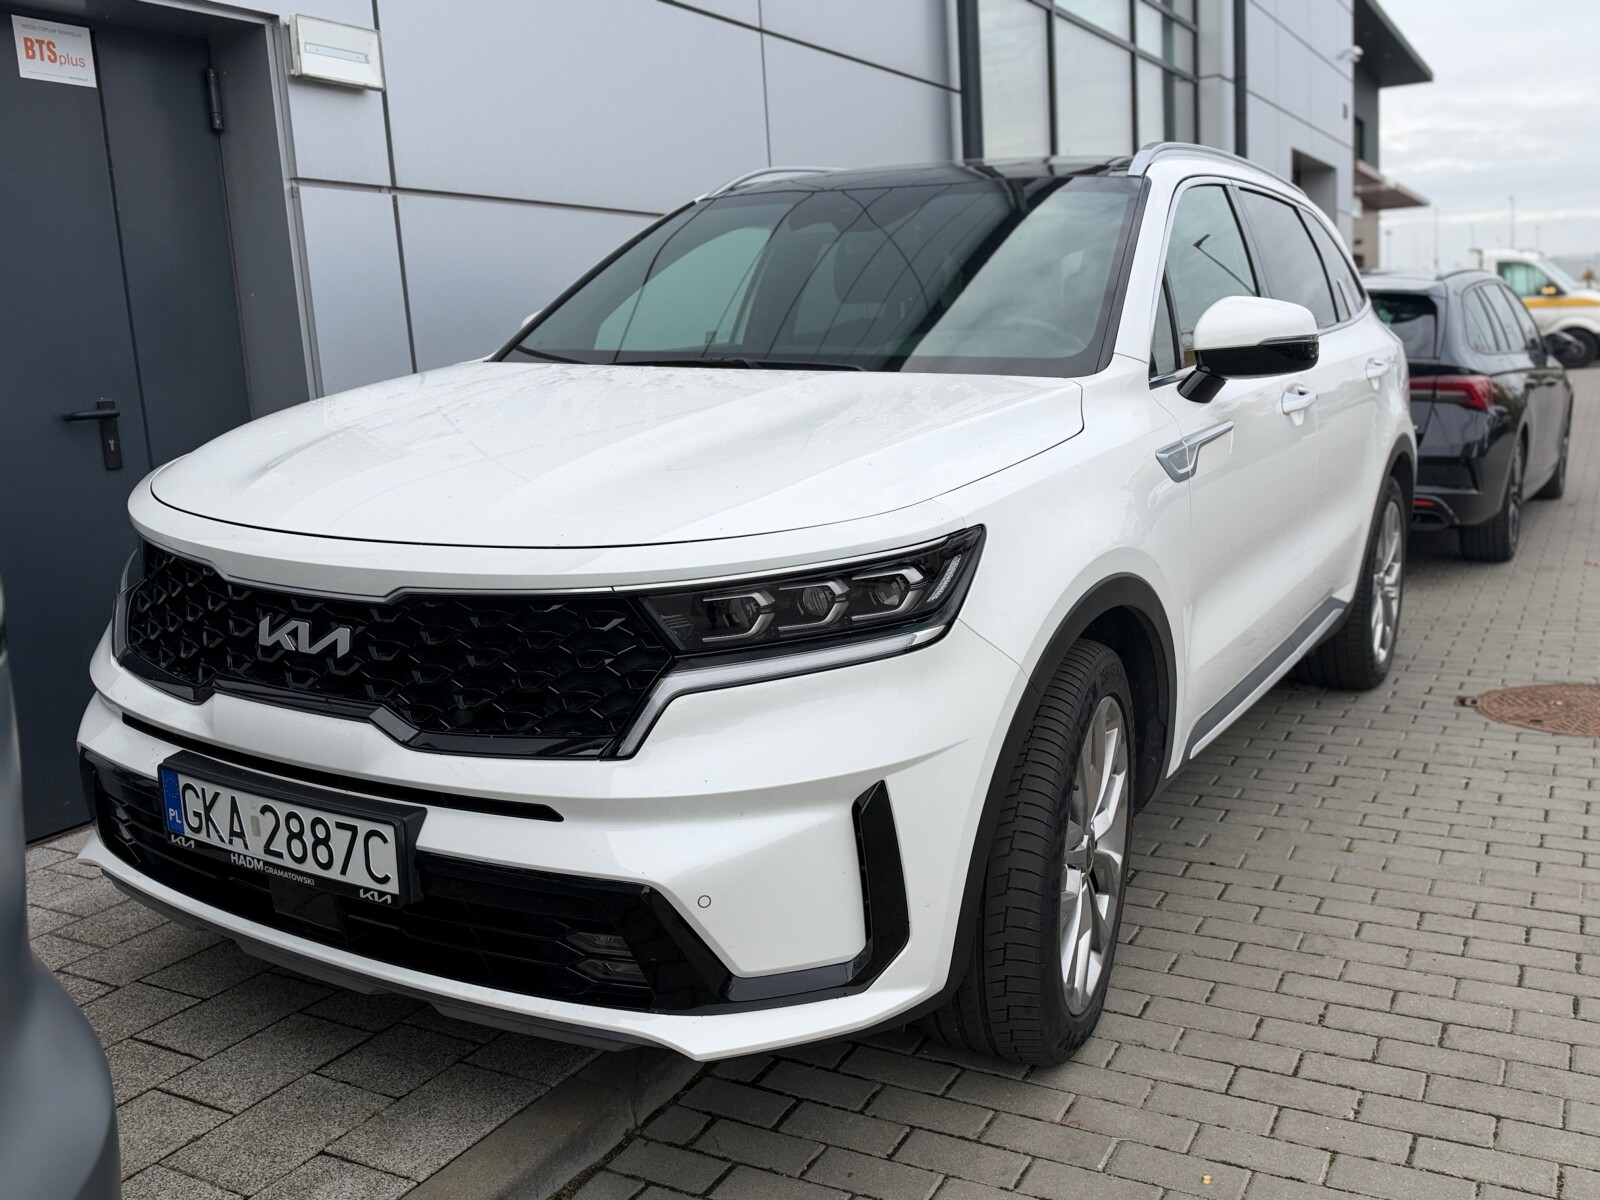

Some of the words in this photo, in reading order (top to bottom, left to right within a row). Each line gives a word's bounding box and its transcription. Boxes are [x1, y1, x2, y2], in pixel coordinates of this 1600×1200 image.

[258, 615, 350, 659] KIA
[168, 808, 182, 824] PL
[171, 834, 195, 849] KIA
[181, 782, 250, 850] GKA
[259, 804, 392, 885] 2887C
[230, 852, 264, 872] HADM
[264, 865, 315, 886] GRAMATOWSKI
[359, 888, 392, 904] KIA
